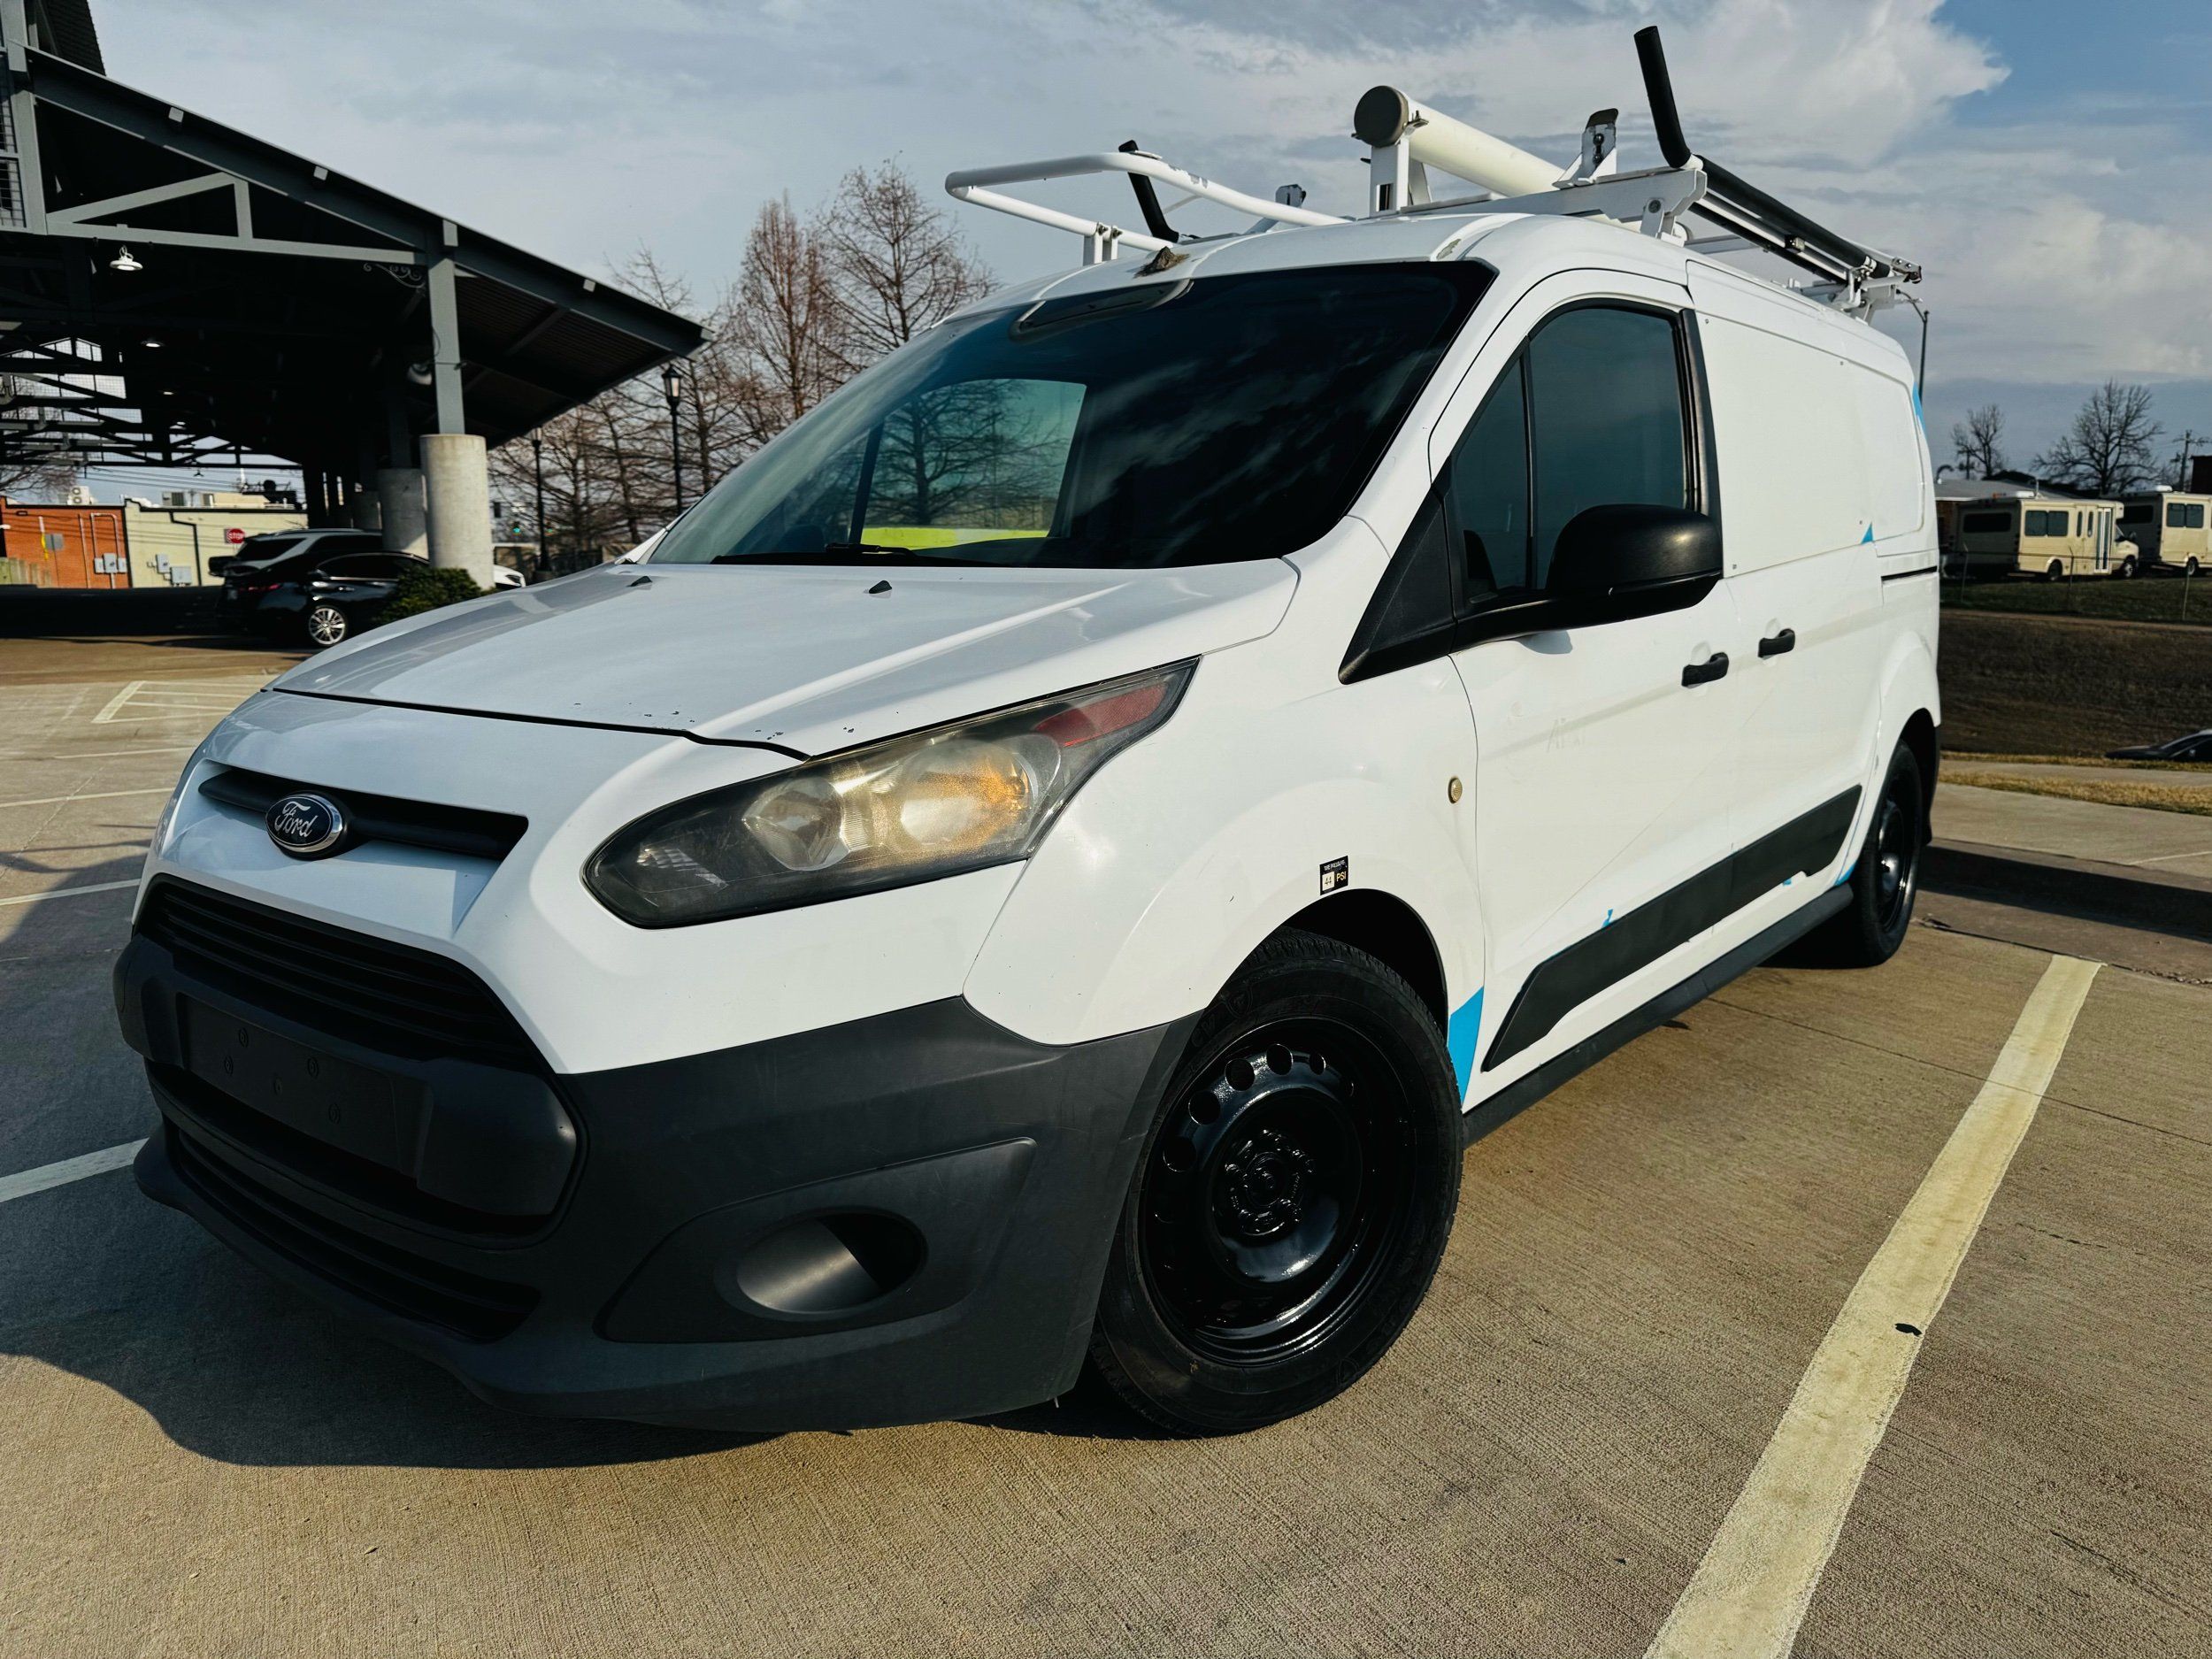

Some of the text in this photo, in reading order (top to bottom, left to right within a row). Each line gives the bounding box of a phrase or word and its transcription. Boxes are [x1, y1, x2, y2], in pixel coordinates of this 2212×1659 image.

[227, 532, 244, 541] STOP
[273, 801, 319, 838] Ford
[1336, 871, 1347, 882] PSI
